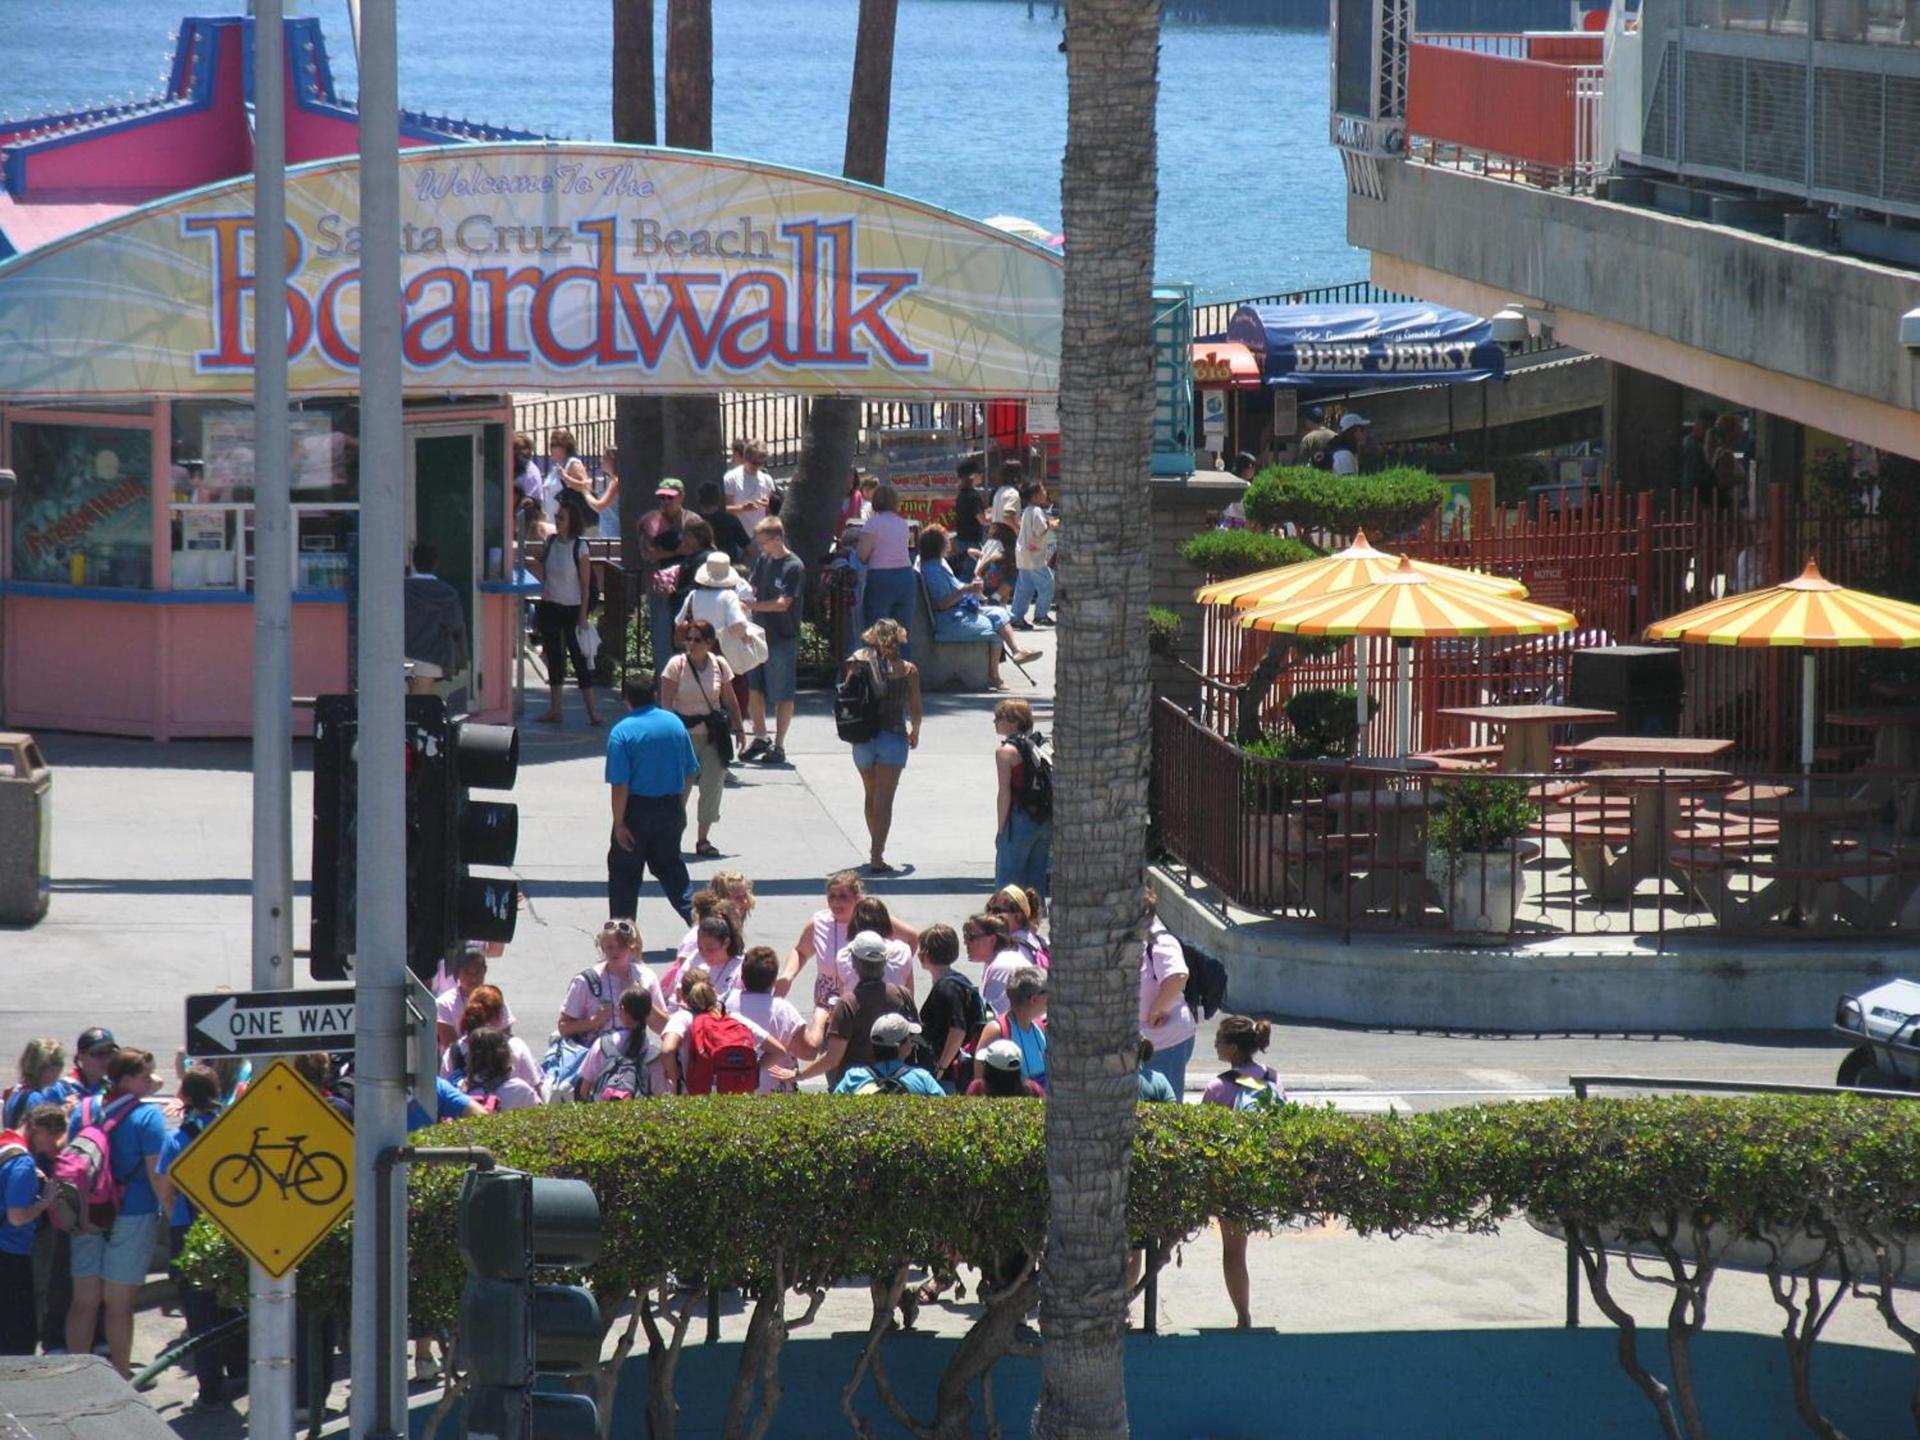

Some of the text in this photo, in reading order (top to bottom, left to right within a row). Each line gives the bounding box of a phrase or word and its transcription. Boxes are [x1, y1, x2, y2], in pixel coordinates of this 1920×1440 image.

[416, 163, 655, 200] Welcome To The
[315, 214, 773, 259] Sata Cruz Beach
[184, 214, 929, 369] Boardwalk
[1294, 341, 1477, 372] BEEF JERKY
[1533, 568, 1562, 578] NOTICE
[229, 1007, 353, 1036] ONE WAY
